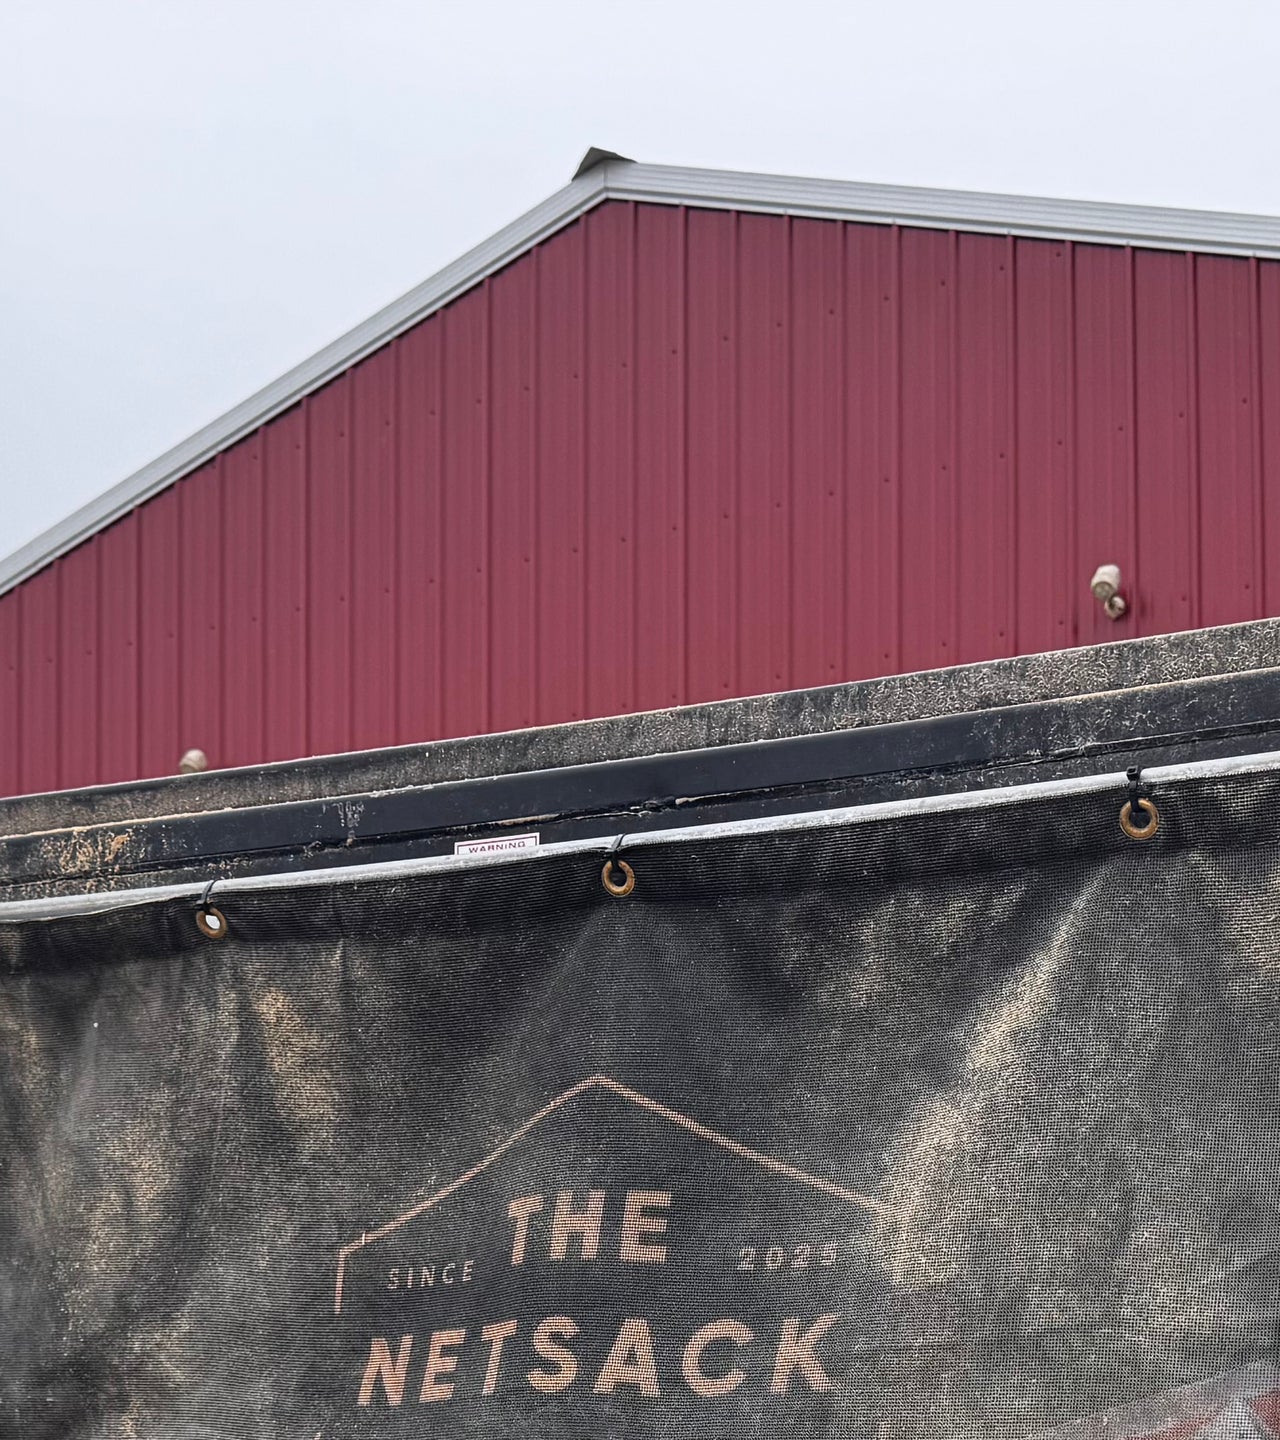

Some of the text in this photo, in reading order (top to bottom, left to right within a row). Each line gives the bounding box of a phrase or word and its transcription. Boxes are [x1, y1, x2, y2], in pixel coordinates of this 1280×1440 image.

[468, 840, 526, 854] WARNING
[506, 1189, 673, 1266] THE
[387, 1260, 475, 1290] SINCE
[357, 1312, 838, 1407] NETSACK
